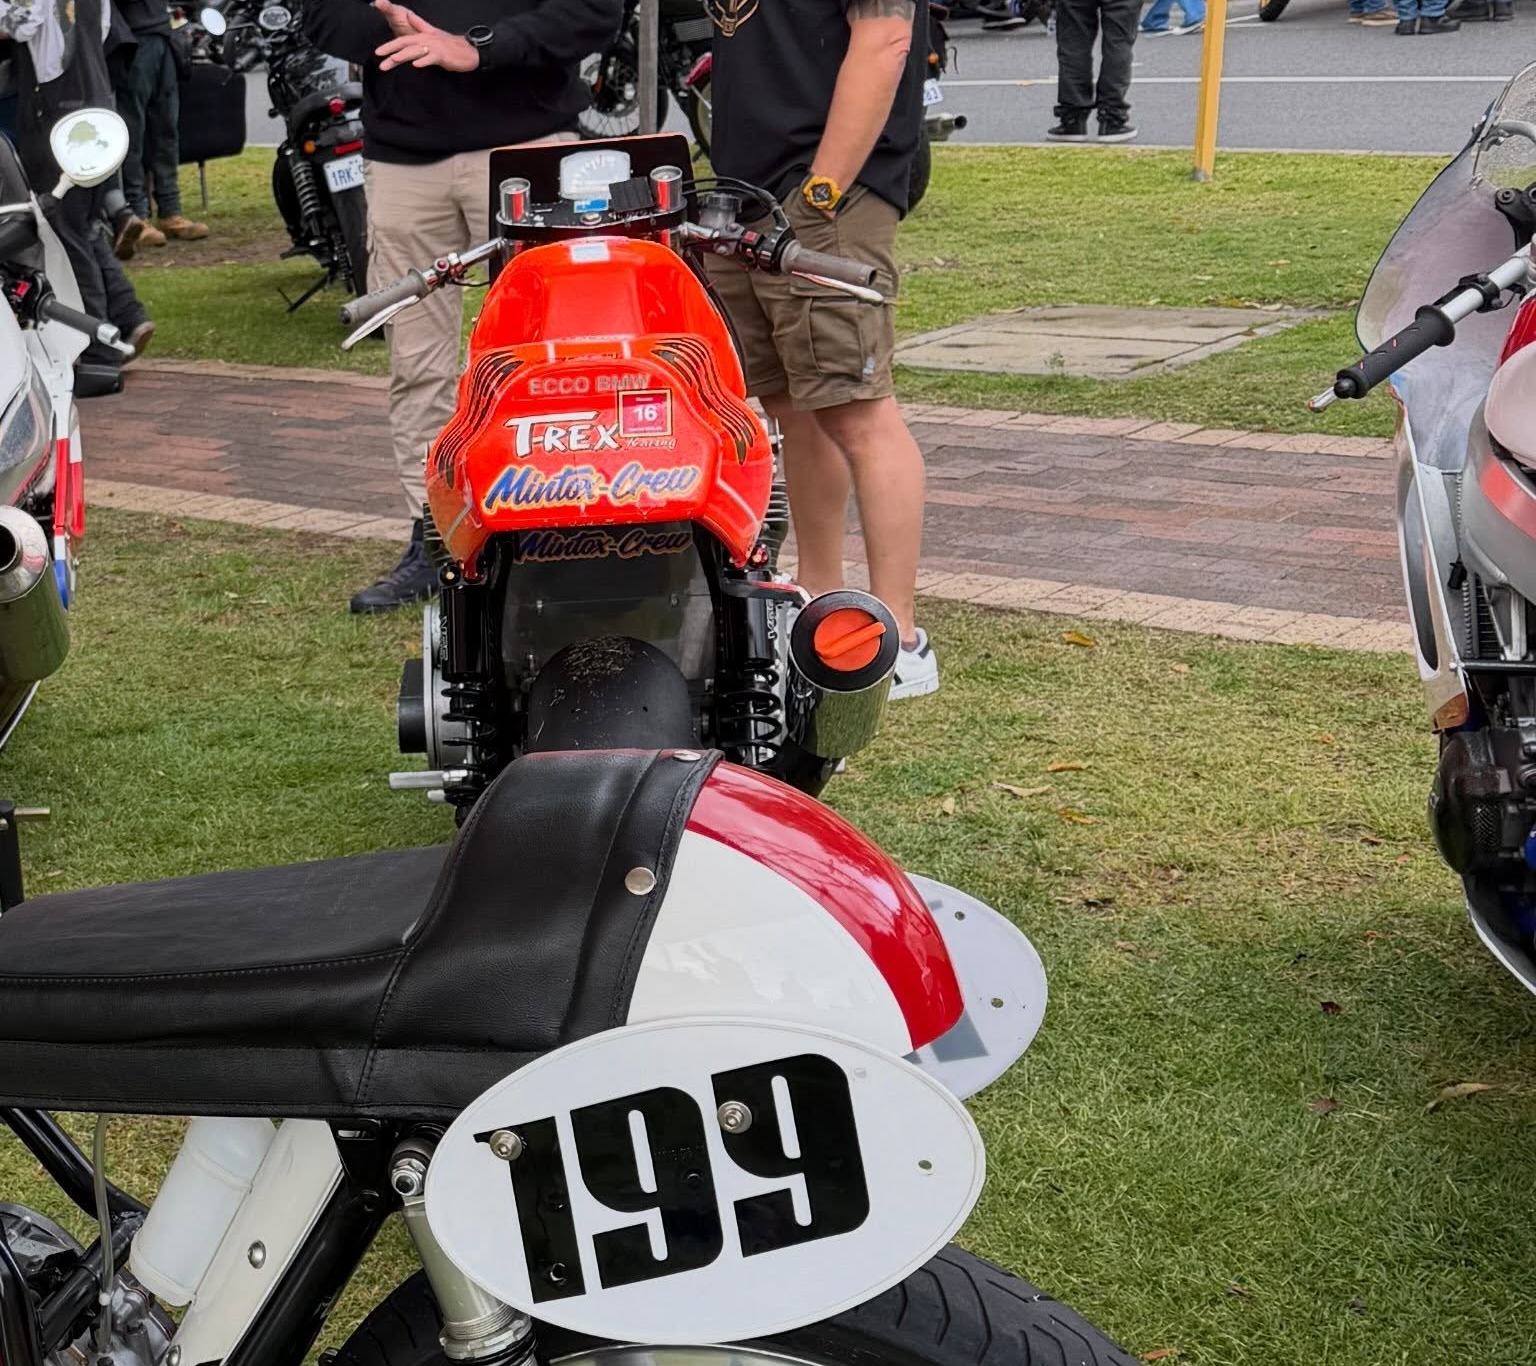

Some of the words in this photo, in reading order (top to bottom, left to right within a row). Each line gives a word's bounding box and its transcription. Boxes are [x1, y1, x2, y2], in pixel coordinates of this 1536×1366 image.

[529, 377, 590, 395] ECCO
[633, 405, 658, 422] 16
[503, 410, 622, 459] T-REX
[473, 1053, 871, 1304] 199
